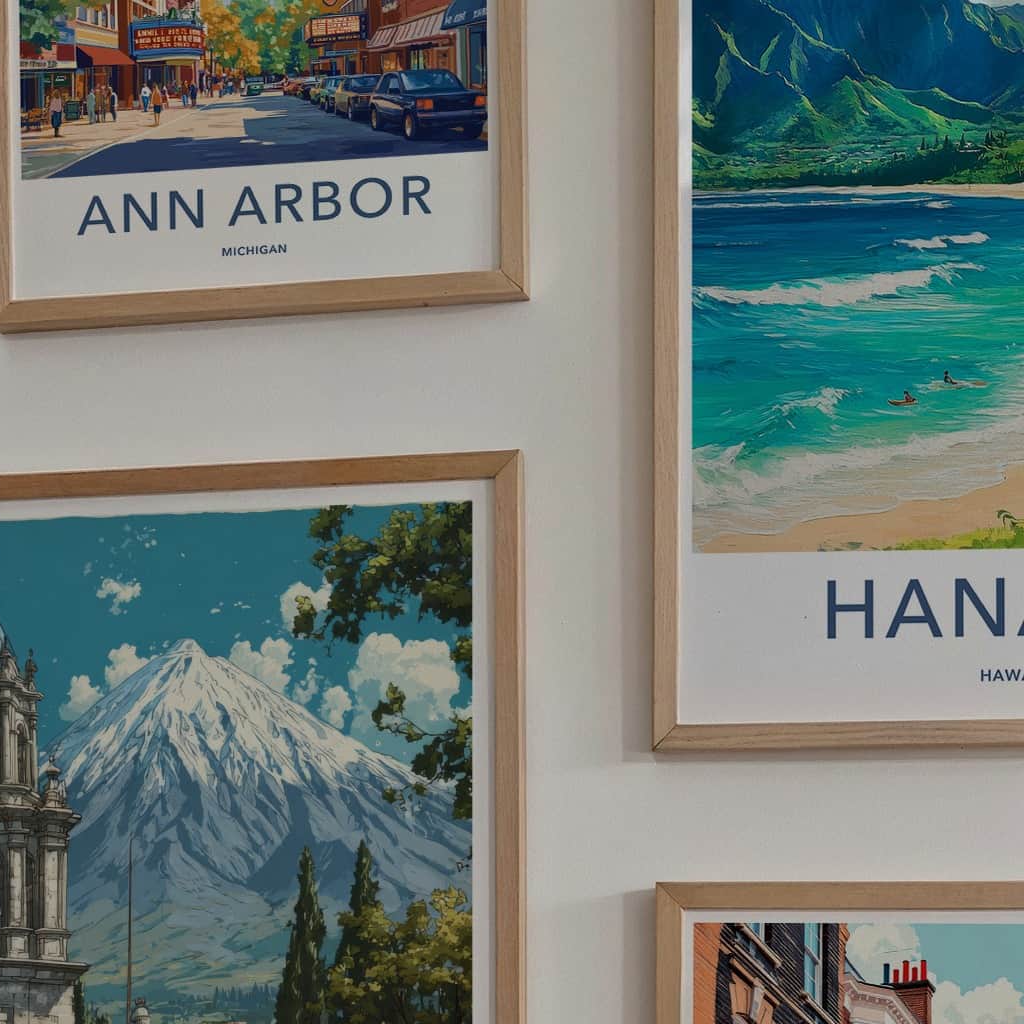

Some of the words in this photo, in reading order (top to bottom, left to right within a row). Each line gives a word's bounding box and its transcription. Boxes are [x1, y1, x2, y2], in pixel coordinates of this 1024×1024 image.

[77, 188, 204, 236] ANN
[228, 175, 432, 227] ARBOR
[221, 243, 288, 257] MICHIGAN
[826, 577, 1024, 639] HAN
[980, 668, 1024, 682] HAW
